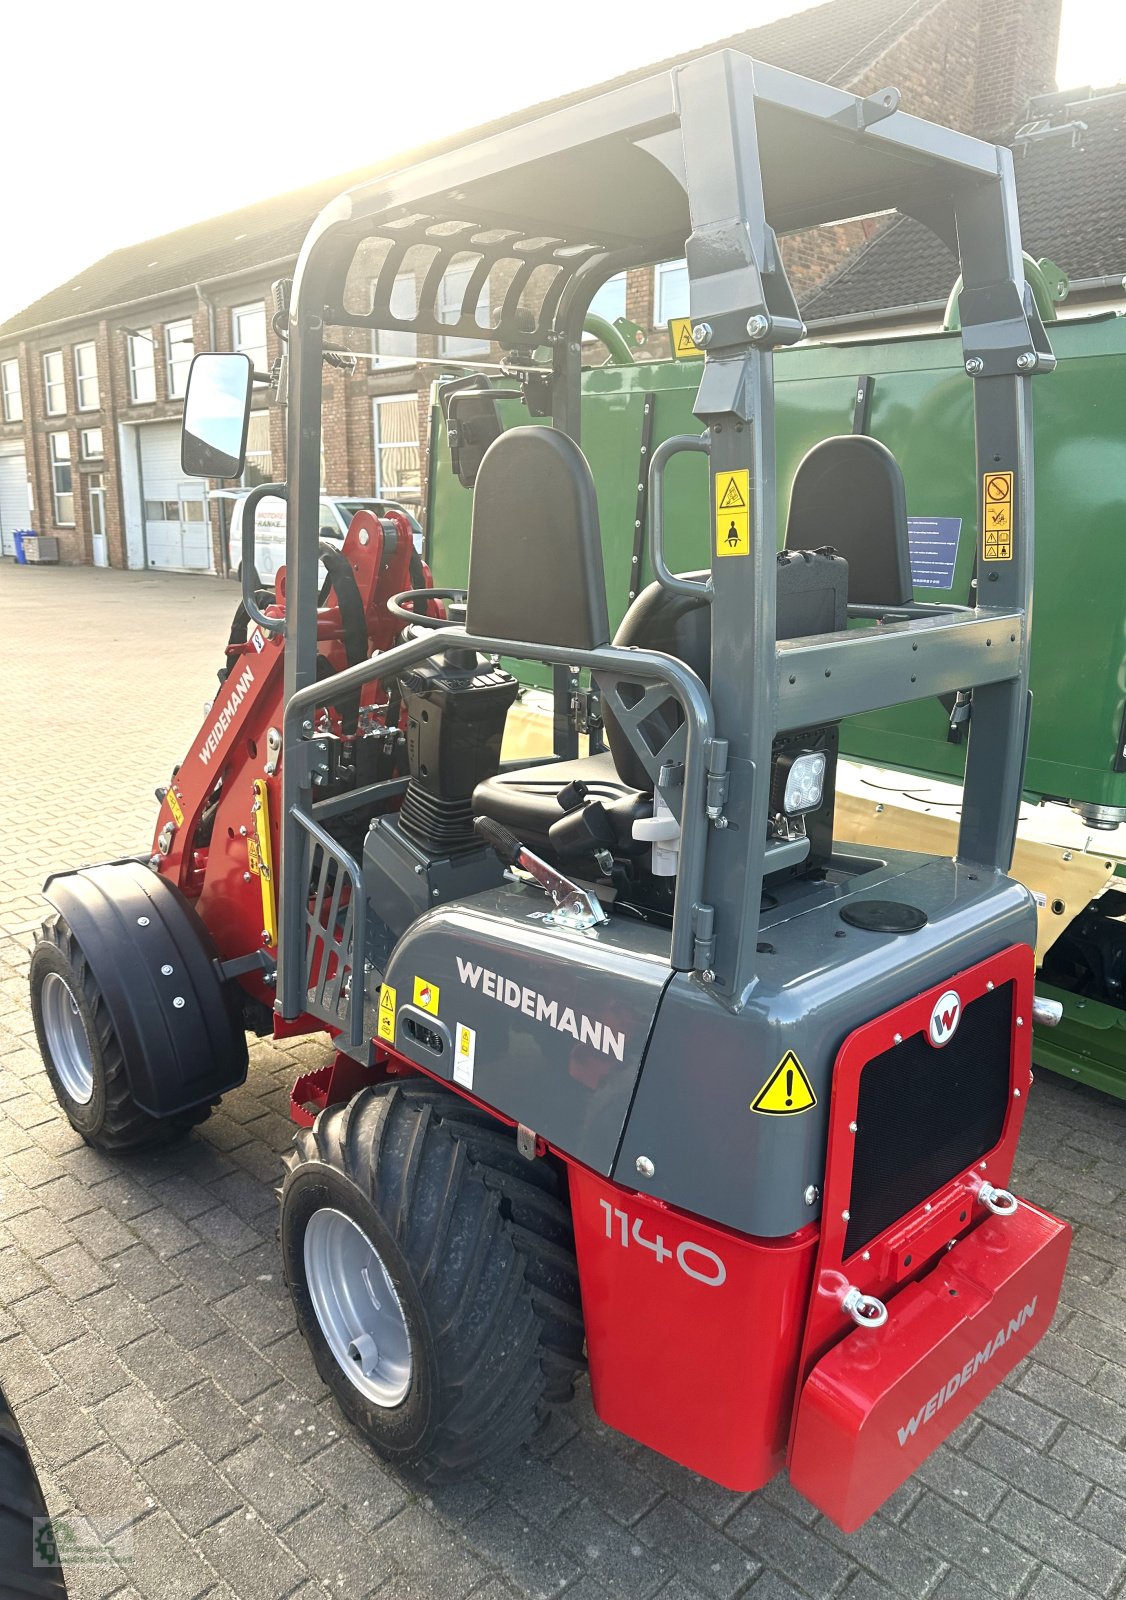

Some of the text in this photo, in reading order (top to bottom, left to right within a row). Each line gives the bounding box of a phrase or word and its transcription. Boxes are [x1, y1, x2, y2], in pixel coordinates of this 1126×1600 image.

[199, 665, 255, 765] WEIDEMANN
[456, 956, 625, 1062] WEIDEMANN
[934, 1004, 959, 1037] W
[600, 1198, 727, 1287] 1140
[897, 1295, 1037, 1447] WEIDEMANN
